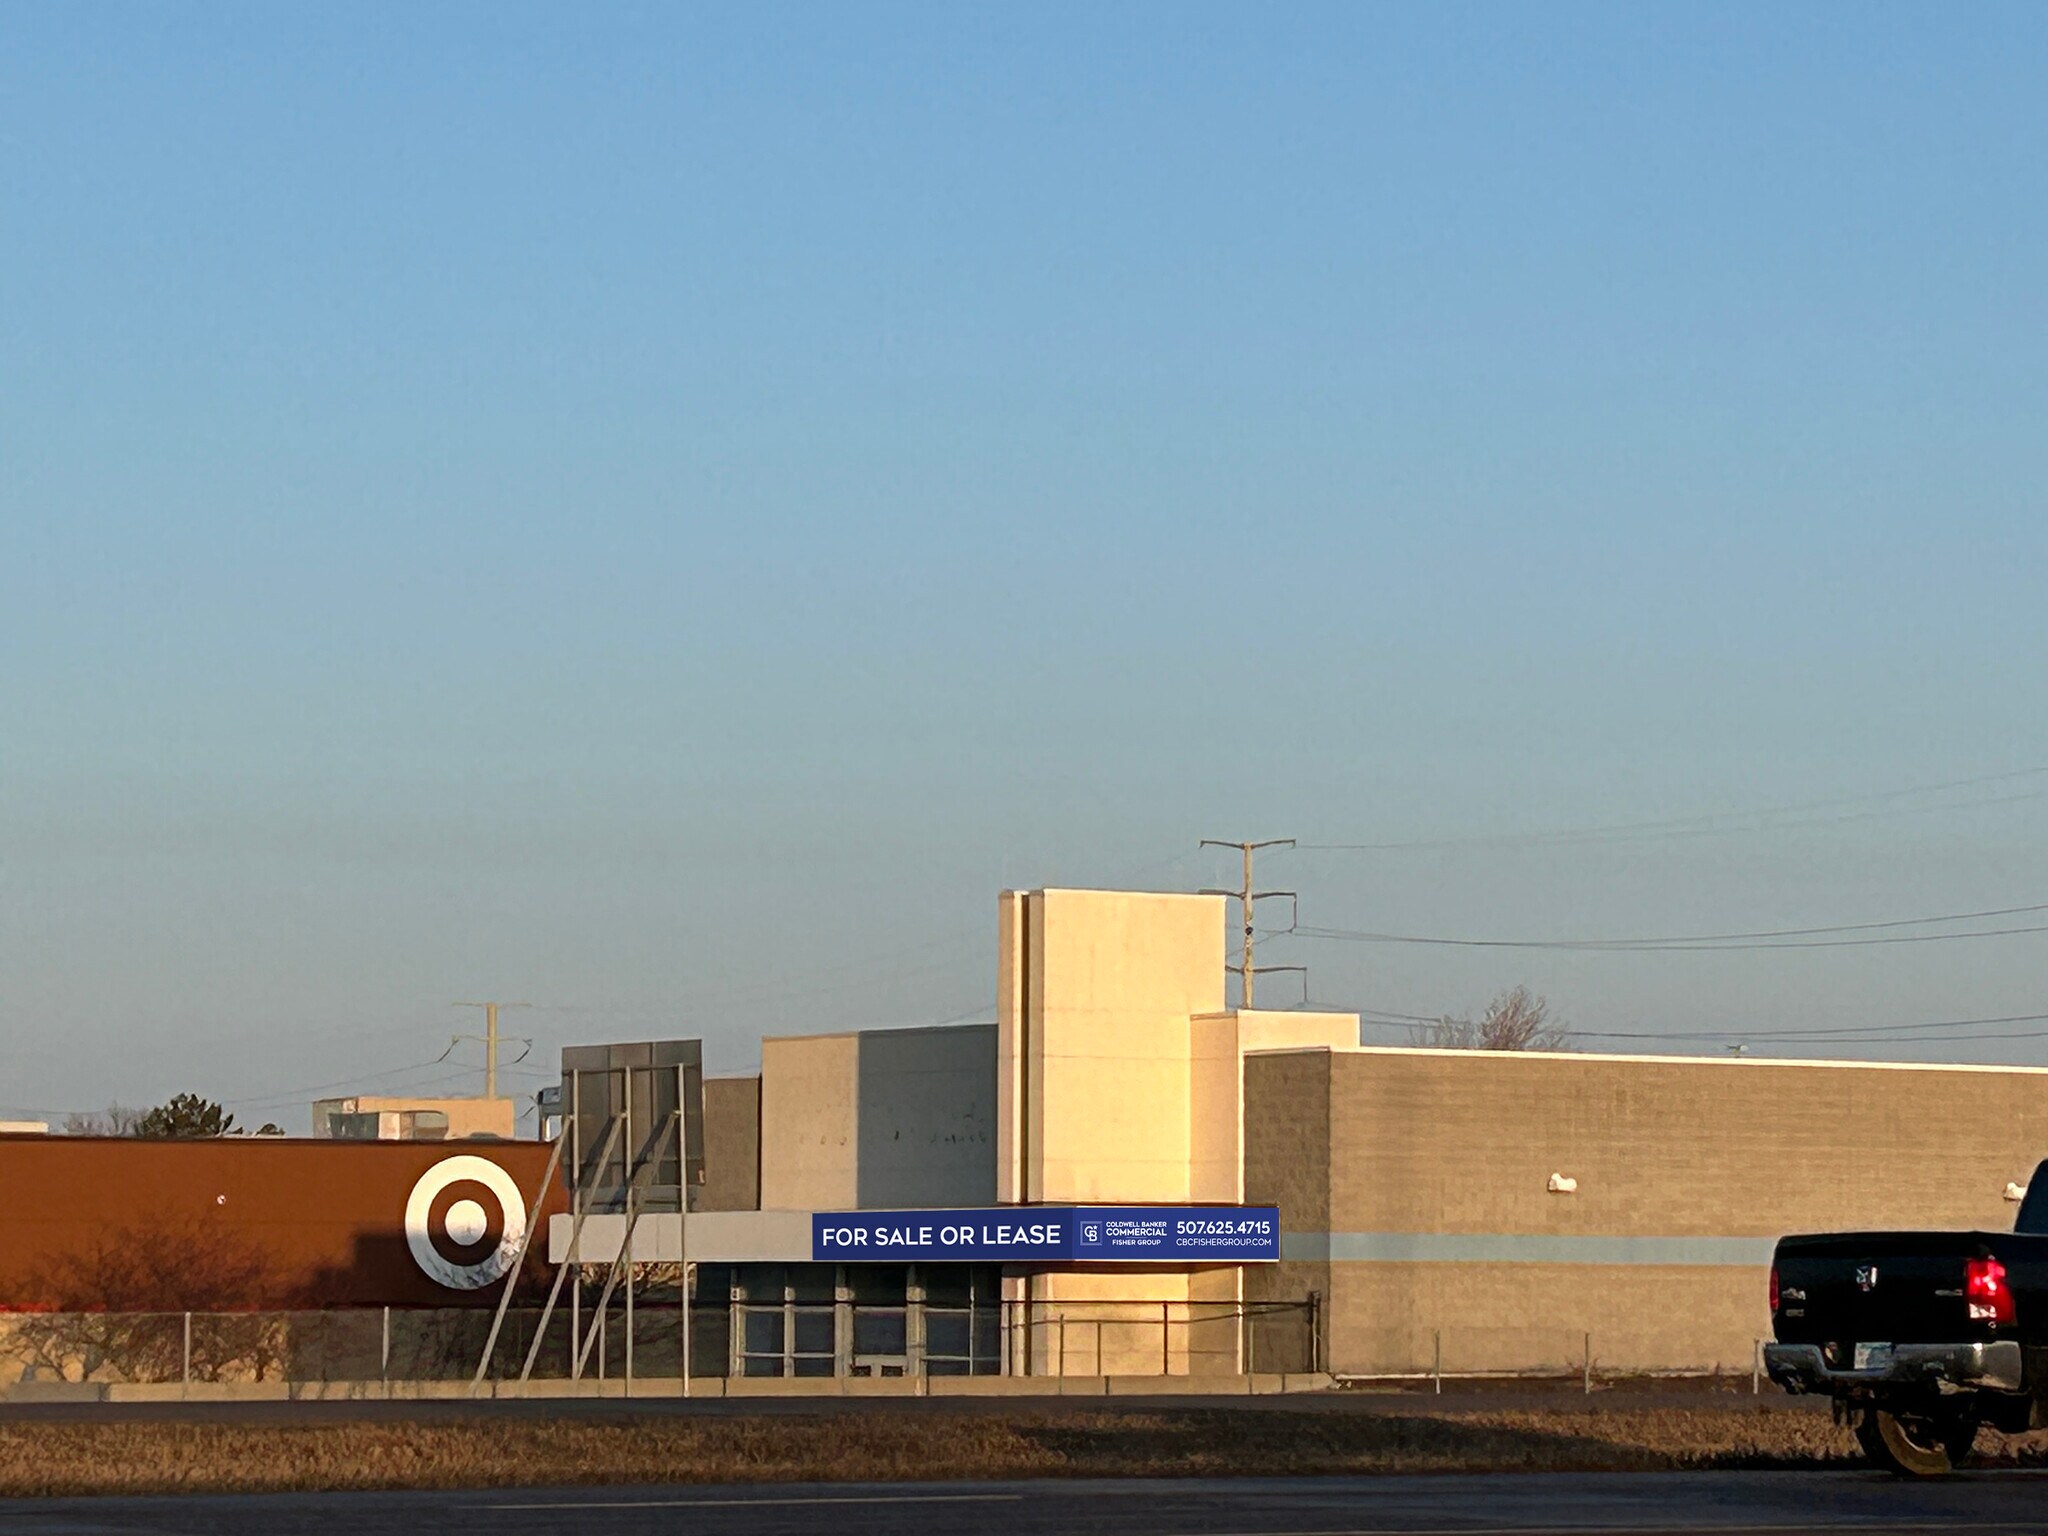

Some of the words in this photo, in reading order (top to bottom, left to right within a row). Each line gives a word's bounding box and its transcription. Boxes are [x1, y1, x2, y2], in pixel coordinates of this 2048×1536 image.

[1105, 1228, 1167, 1236] COMMERCIAL
[1176, 1220, 1271, 1235] 507.625.4715
[822, 1228, 868, 1246] FOR
[874, 1226, 933, 1246] SALE
[939, 1225, 975, 1246] OR
[982, 1224, 1062, 1245] LEASE
[1176, 1238, 1272, 1246] CBCFISHERGROUP.COM
